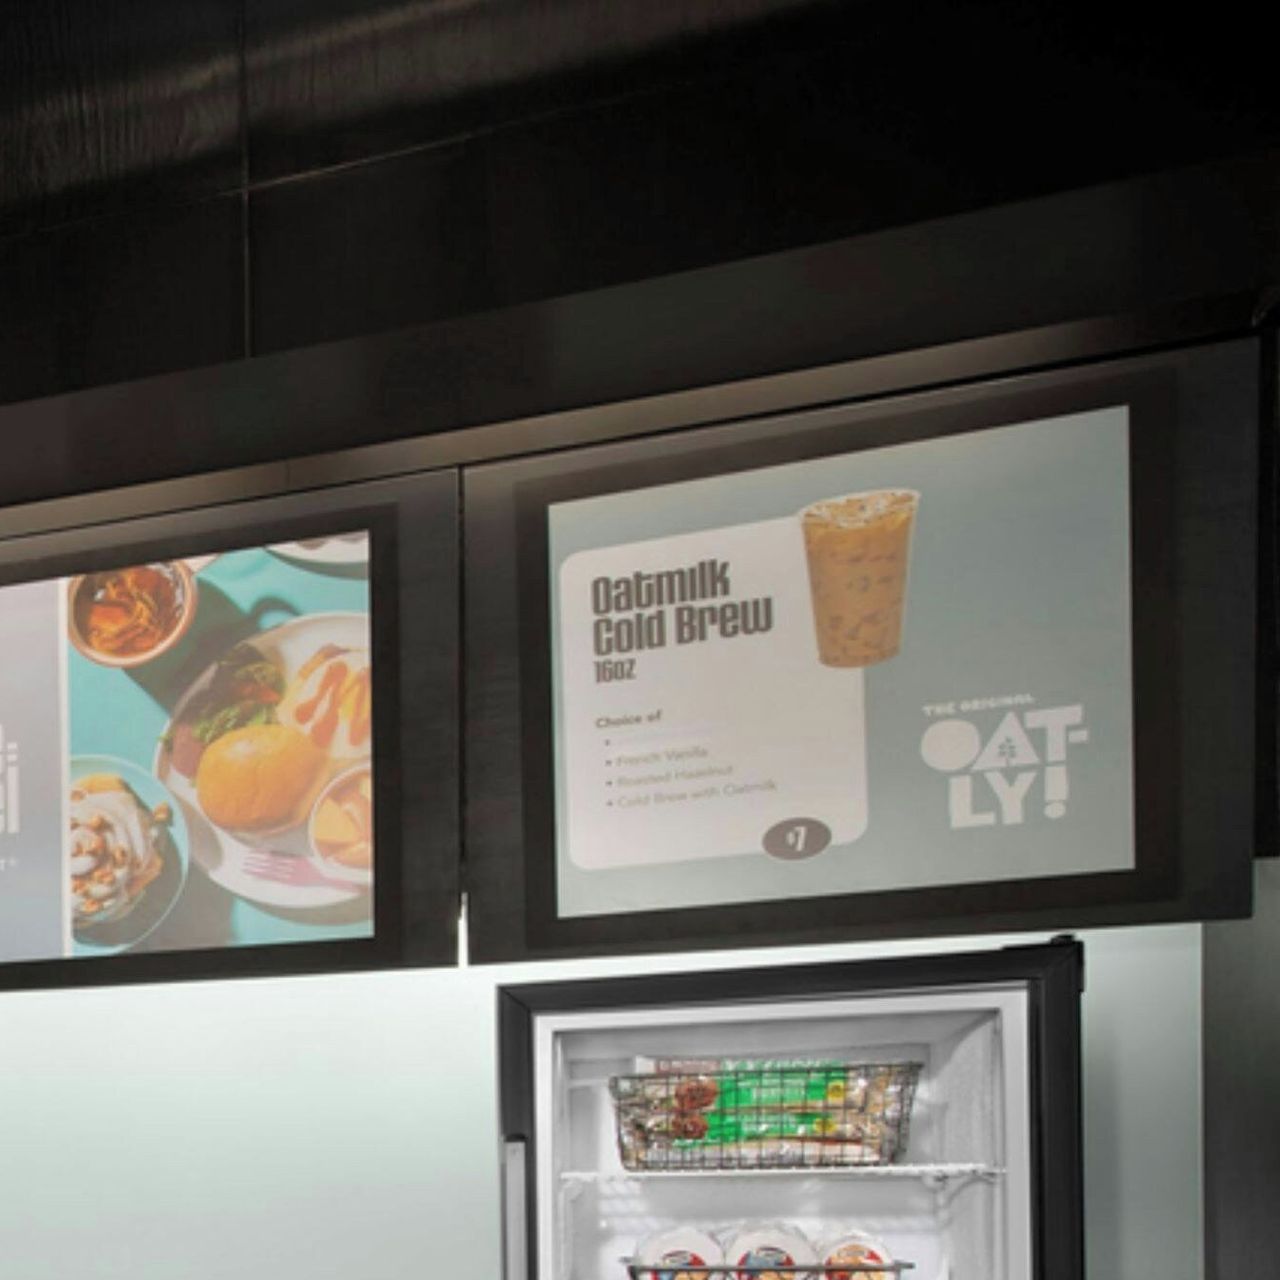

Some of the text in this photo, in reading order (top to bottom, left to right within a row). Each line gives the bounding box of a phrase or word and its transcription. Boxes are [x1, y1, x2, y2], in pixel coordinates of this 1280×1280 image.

[592, 559, 731, 616] Oatmilk
[593, 597, 773, 656] Cold Brew
[596, 714, 642, 728] Choice
[922, 692, 1036, 716] THE ORIGINAL
